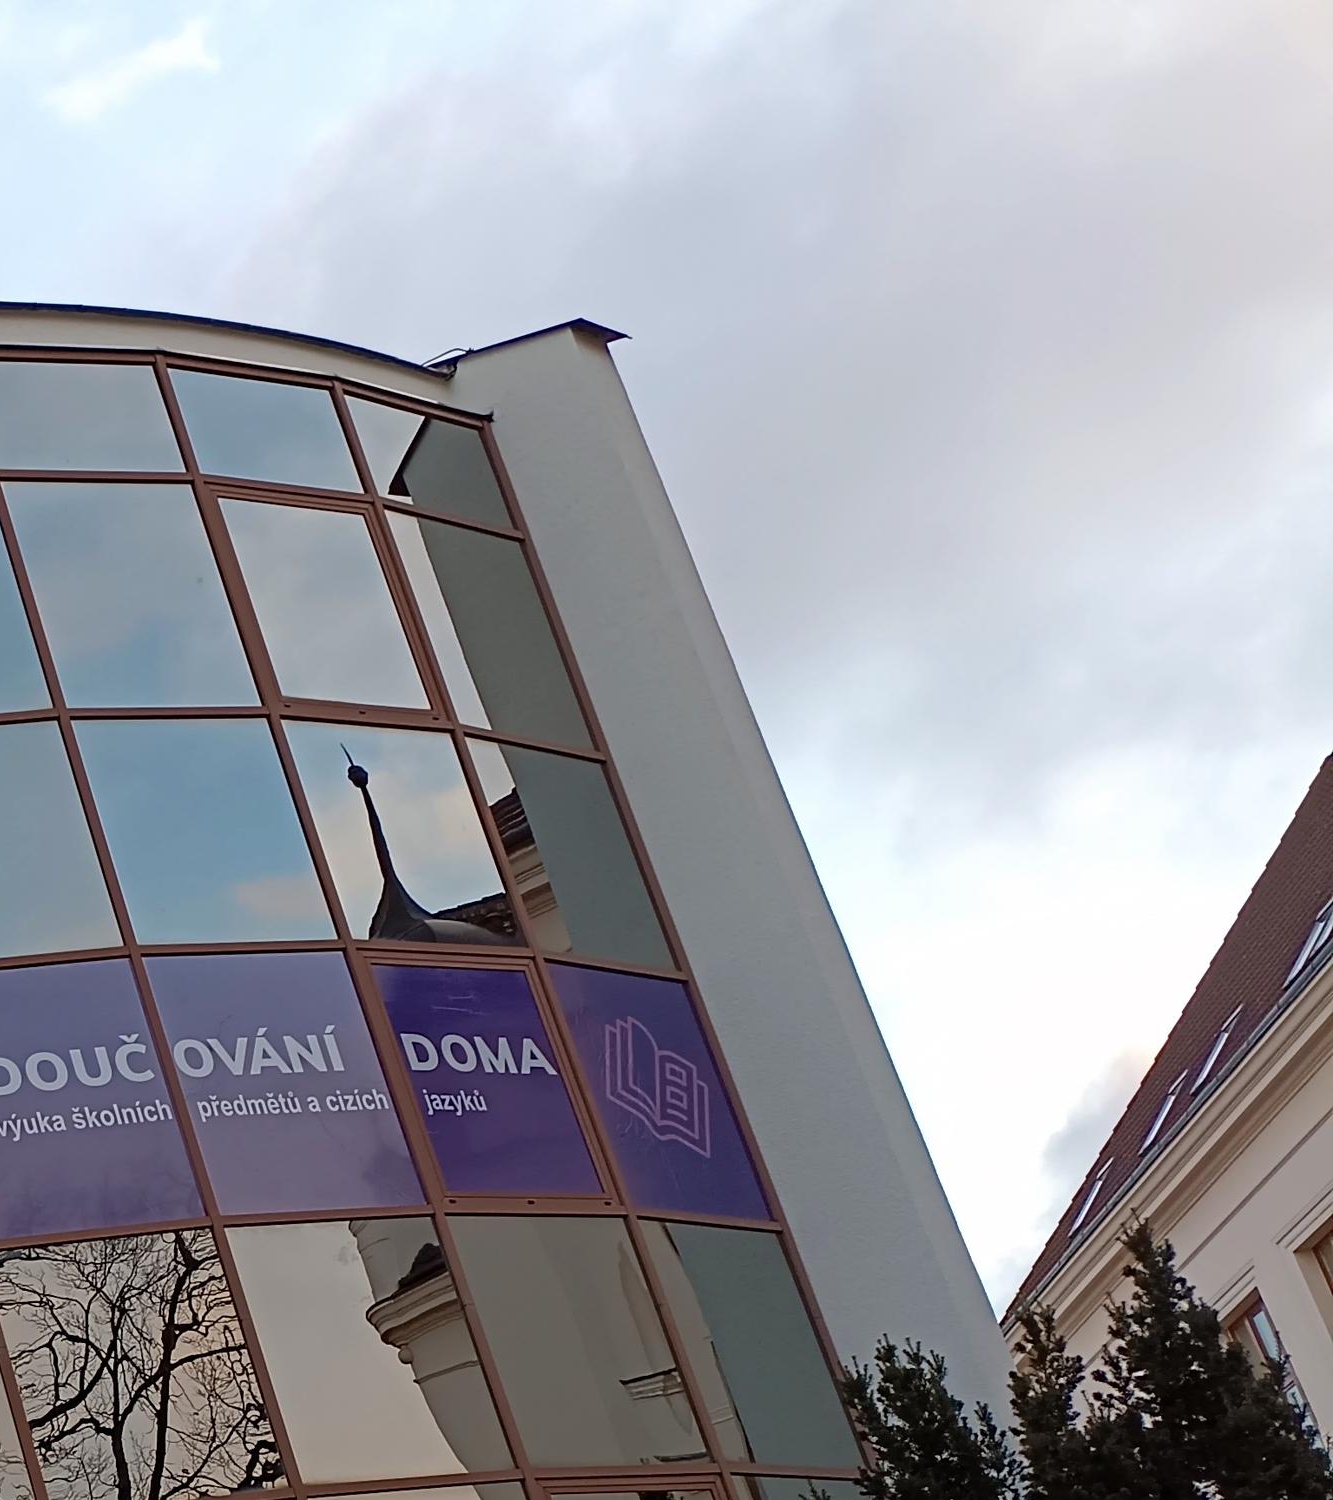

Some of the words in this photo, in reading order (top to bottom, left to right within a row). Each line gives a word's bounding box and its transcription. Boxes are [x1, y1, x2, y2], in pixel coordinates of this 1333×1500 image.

[400, 1032, 559, 1077] DOMA
[71, 1098, 173, 1131] školních
[196, 1089, 302, 1122] předmětů
[307, 1096, 322, 1113] a
[325, 1087, 390, 1112] cizích
[422, 1089, 487, 1116] jazyků
